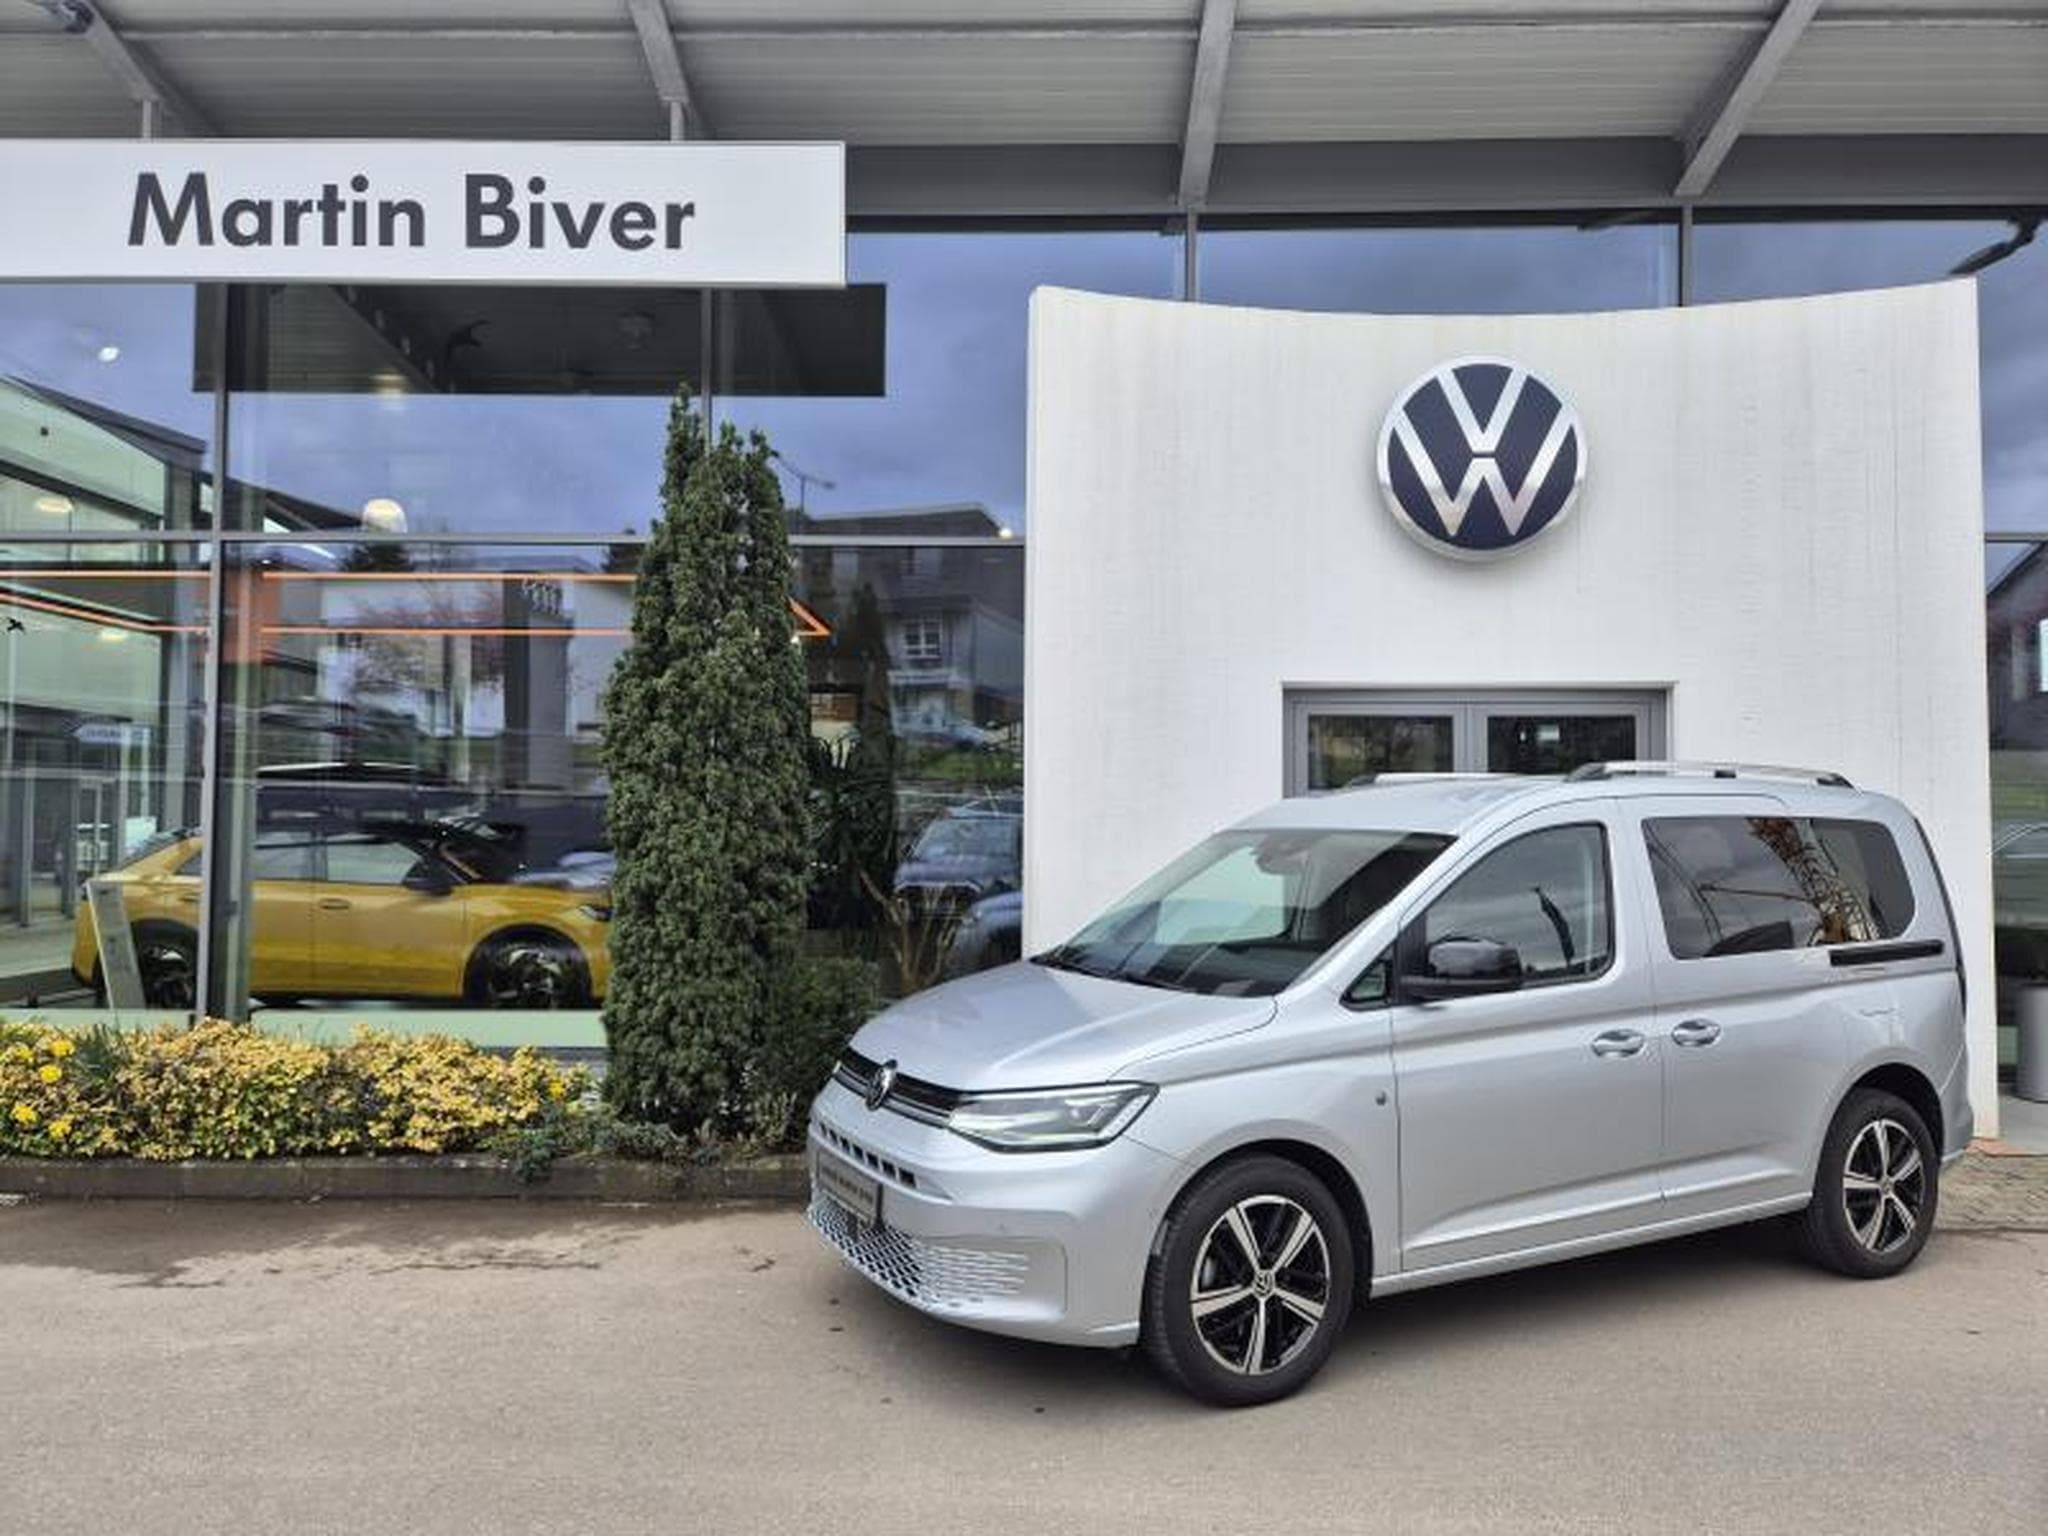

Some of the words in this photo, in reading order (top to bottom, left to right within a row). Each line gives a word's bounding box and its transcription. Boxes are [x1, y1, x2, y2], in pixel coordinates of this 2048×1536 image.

[127, 172, 425, 247] Martin
[465, 173, 695, 250] Biver
[1382, 358, 1584, 550] VW
